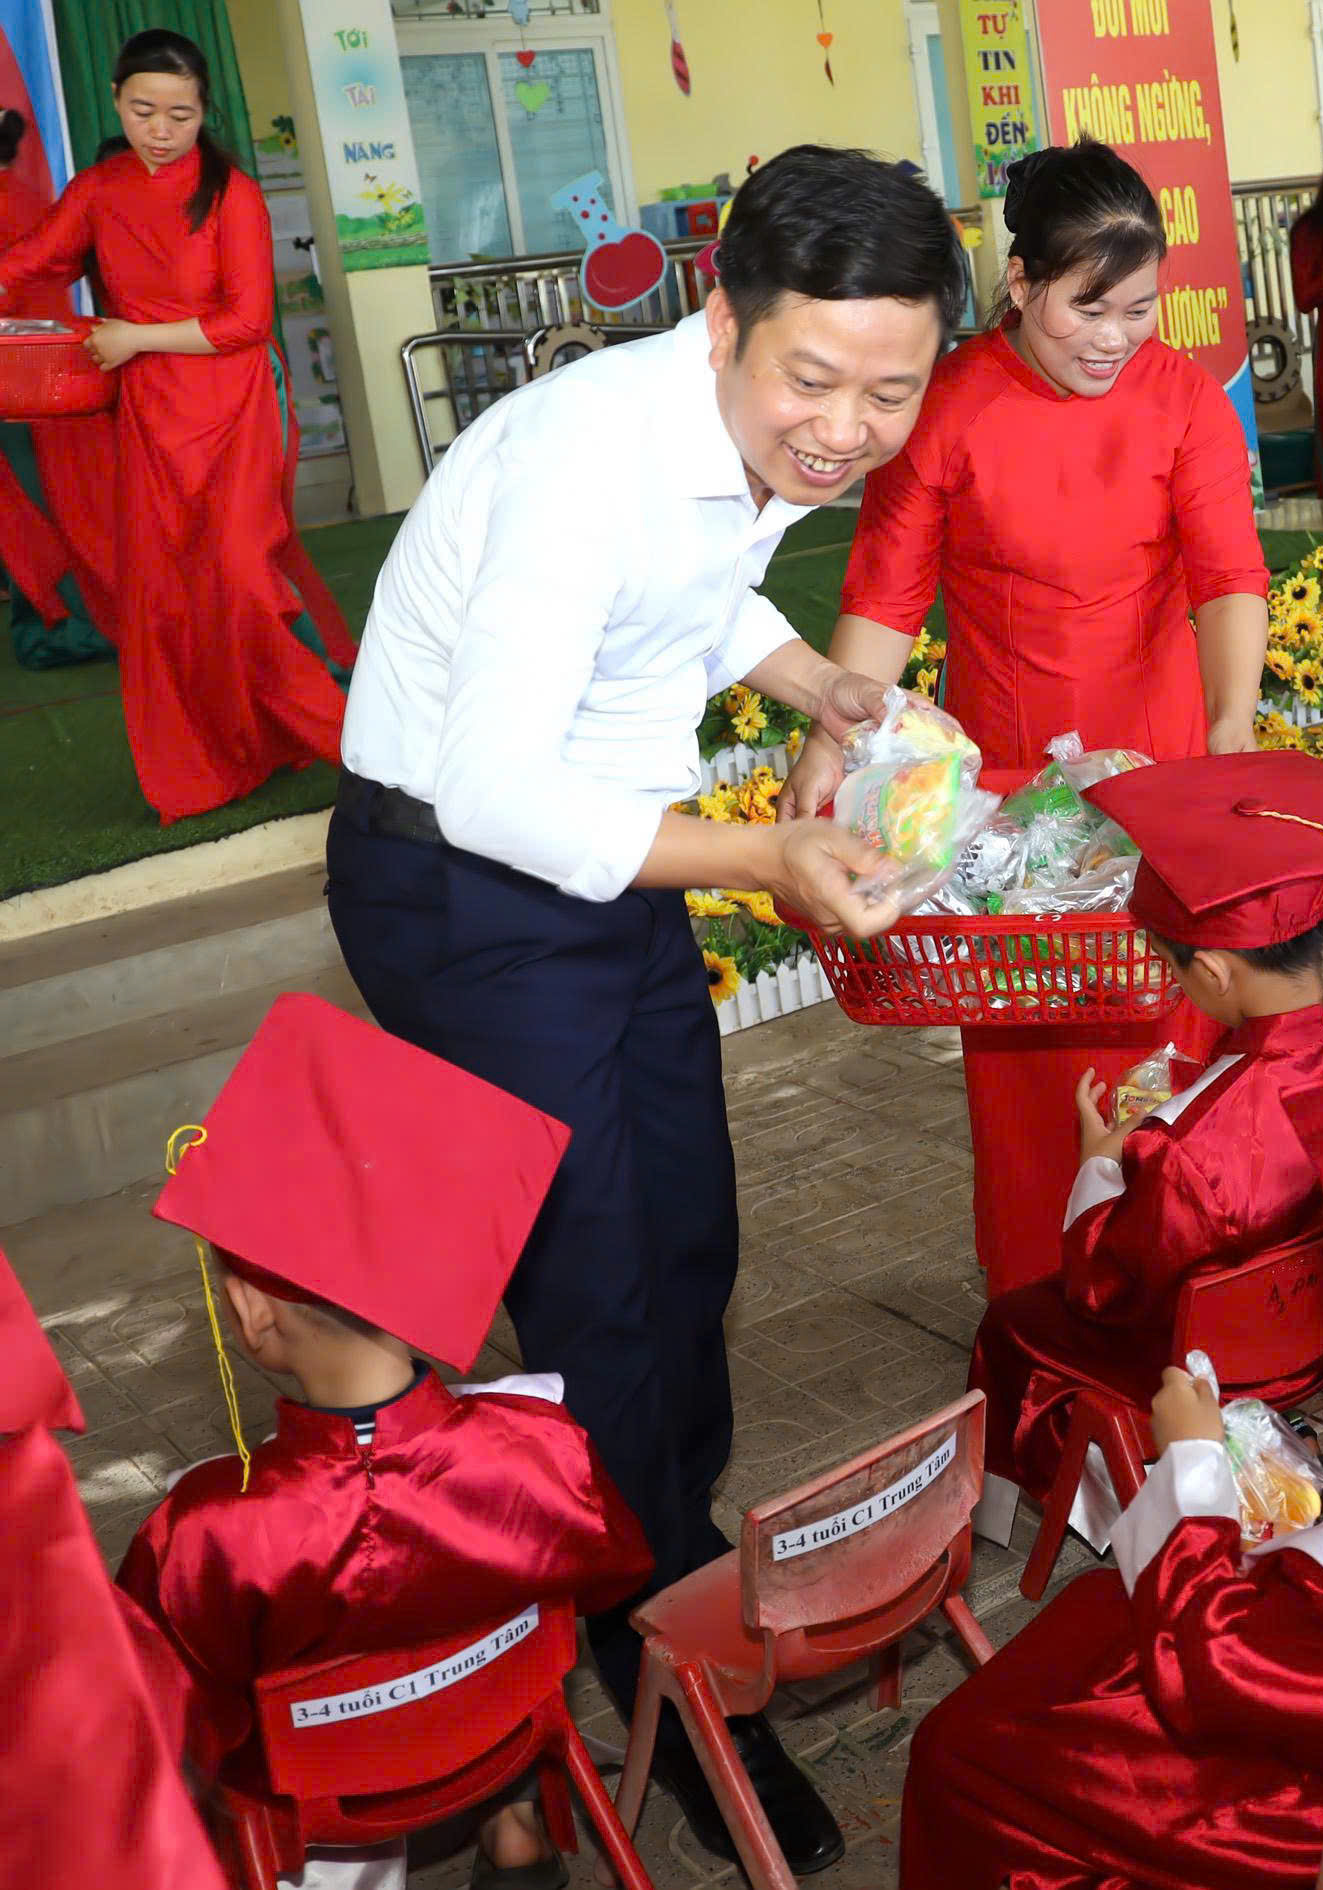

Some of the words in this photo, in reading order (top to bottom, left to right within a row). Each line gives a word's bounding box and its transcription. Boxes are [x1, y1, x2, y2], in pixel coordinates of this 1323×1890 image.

[977, 12, 1008, 40] TỰ
[979, 50, 1016, 71] TIN
[981, 85, 1021, 106] KHI
[1062, 72, 1136, 148] KHÔNG
[1135, 68, 1212, 146] NGỪNG,
[986, 111, 1026, 145] ĐẾN
[1159, 184, 1200, 247] CAO
[777, 1536, 806, 1554] 3-4
[812, 1515, 847, 1543] tuổi
[851, 1508, 874, 1526] C1
[878, 1476, 923, 1513] Trung
[924, 1449, 951, 1481] Tâm
[297, 1703, 331, 1722] 3-4
[339, 1688, 382, 1714] tuổi
[388, 1680, 417, 1700] C1
[424, 1650, 487, 1688] Trung
[490, 1618, 529, 1651] Tâm
